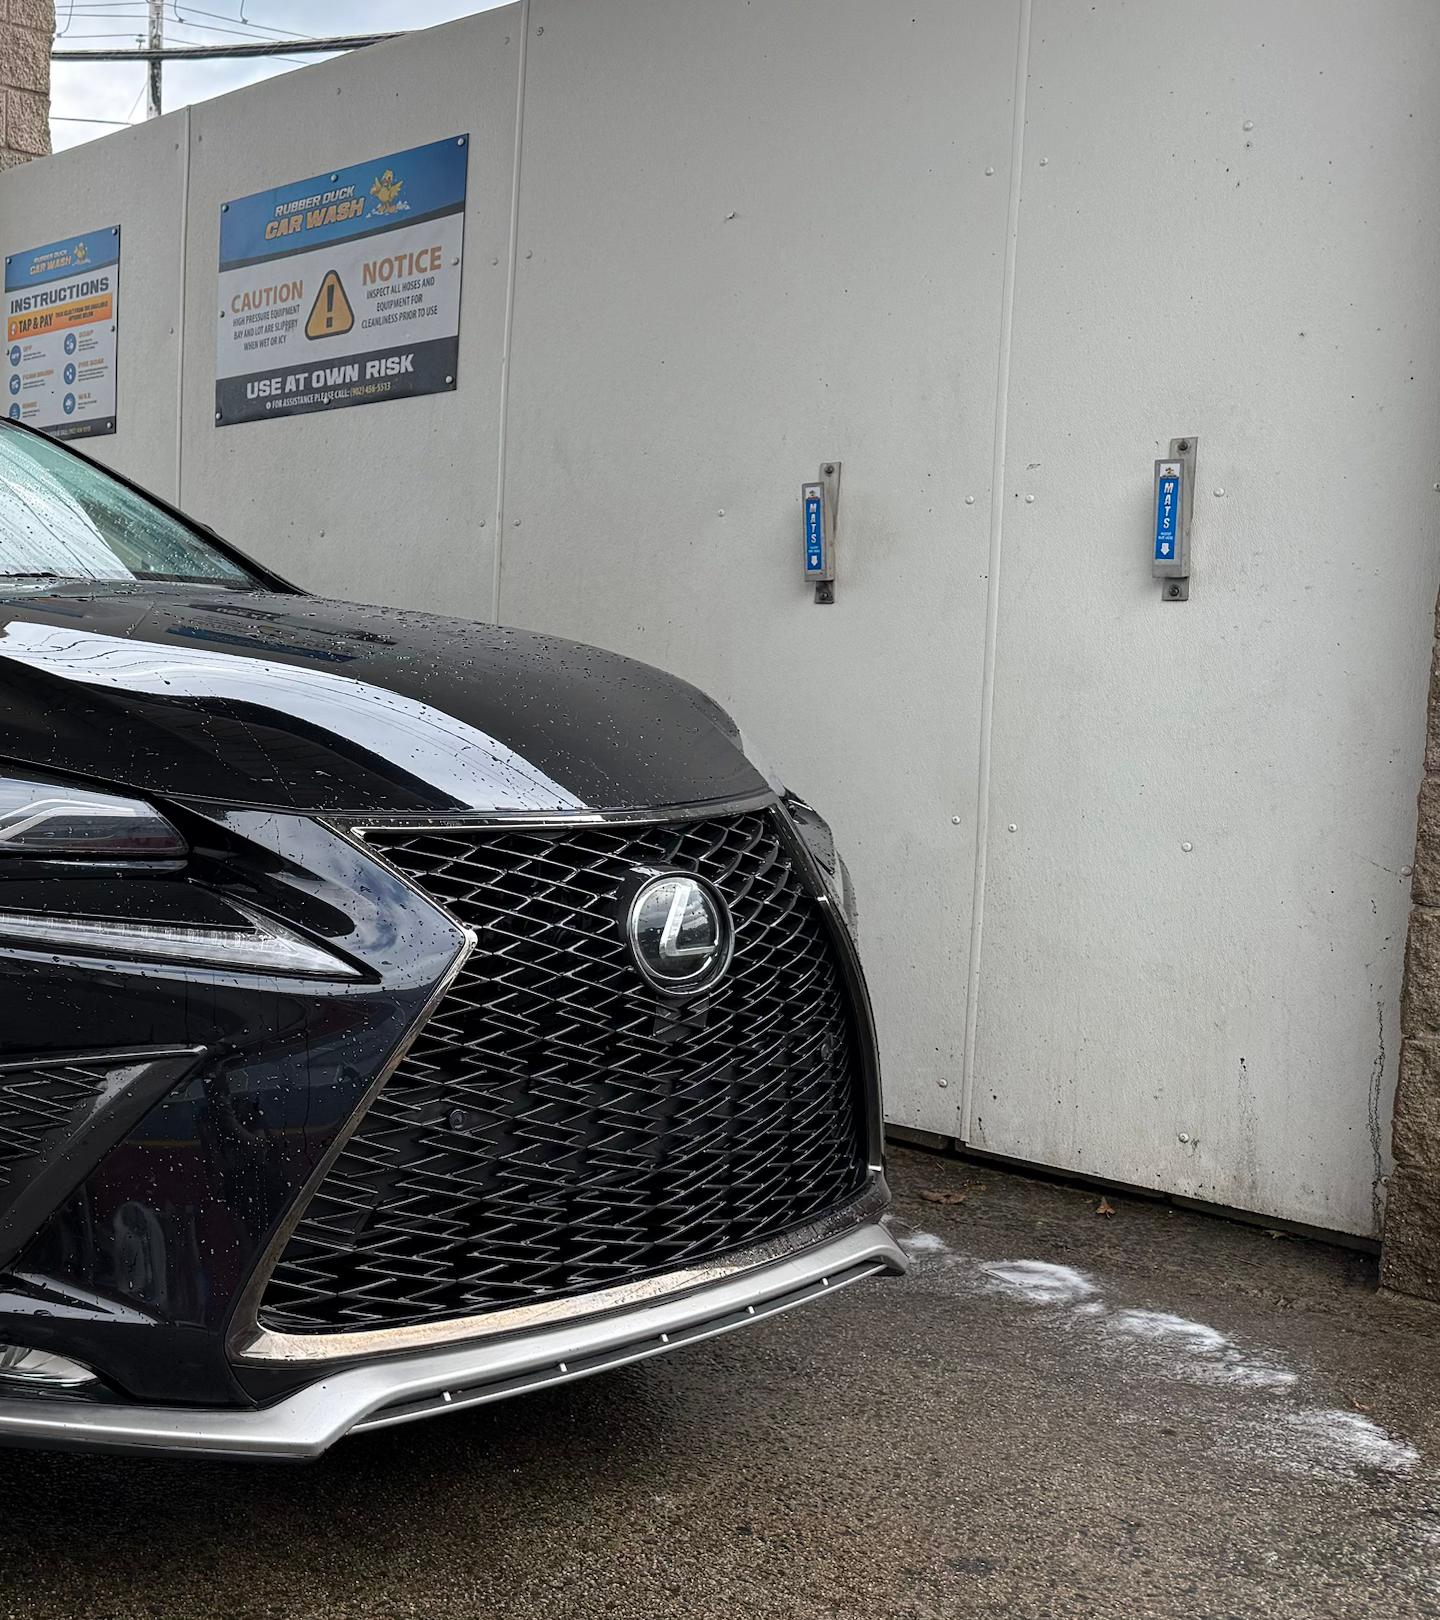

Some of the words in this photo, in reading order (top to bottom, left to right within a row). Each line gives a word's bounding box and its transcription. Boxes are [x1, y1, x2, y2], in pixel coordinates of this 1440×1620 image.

[275, 195, 321, 216] RUBBER
[322, 186, 355, 204] DUCK
[265, 214, 303, 240] CAR
[306, 197, 365, 229] WASH
[30, 264, 46, 275] CAR
[47, 256, 72, 270] WASH
[362, 246, 442, 286] NOTICE
[10, 276, 110, 314] INSTRUCTIONS
[231, 280, 303, 314] CAUTION
[367, 286, 390, 300] INSPECT
[390, 284, 400, 294] ALL
[402, 280, 420, 292] HOSES
[422, 276, 435, 288] AND
[376, 296, 410, 312] EQUIPMENT
[411, 294, 423, 304] FOR
[19, 318, 32, 333] TAP
[32, 318, 39, 330] &
[40, 313, 54, 328] PAY
[232, 316, 246, 327] HIGH
[246, 311, 270, 324] PRESSURE
[270, 304, 300, 319] EQUIPMENT
[362, 313, 398, 329] CLEANLINESS
[398, 310, 418, 322] PRIOR
[418, 308, 426, 318] TO
[426, 305, 438, 317] USE
[234, 330, 244, 340] BAY
[244, 328, 254, 338] AND
[255, 326, 264, 336] LOT
[264, 323, 274, 334] ARE
[244, 340, 258, 351] WHEN
[260, 338, 270, 348] WET
[270, 336, 278, 346] OR
[278, 334, 287, 344] ICY
[246, 377, 282, 399] USE
[284, 372, 309, 393] AT
[312, 364, 359, 388] OWN
[365, 354, 415, 380] RISK
[272, 400, 282, 408] FOR
[283, 394, 314, 407] ASSISTANCE
[314, 390, 334, 402] PLEASE
[1163, 482, 1174, 529] MATS
[810, 503, 818, 543] MATS
